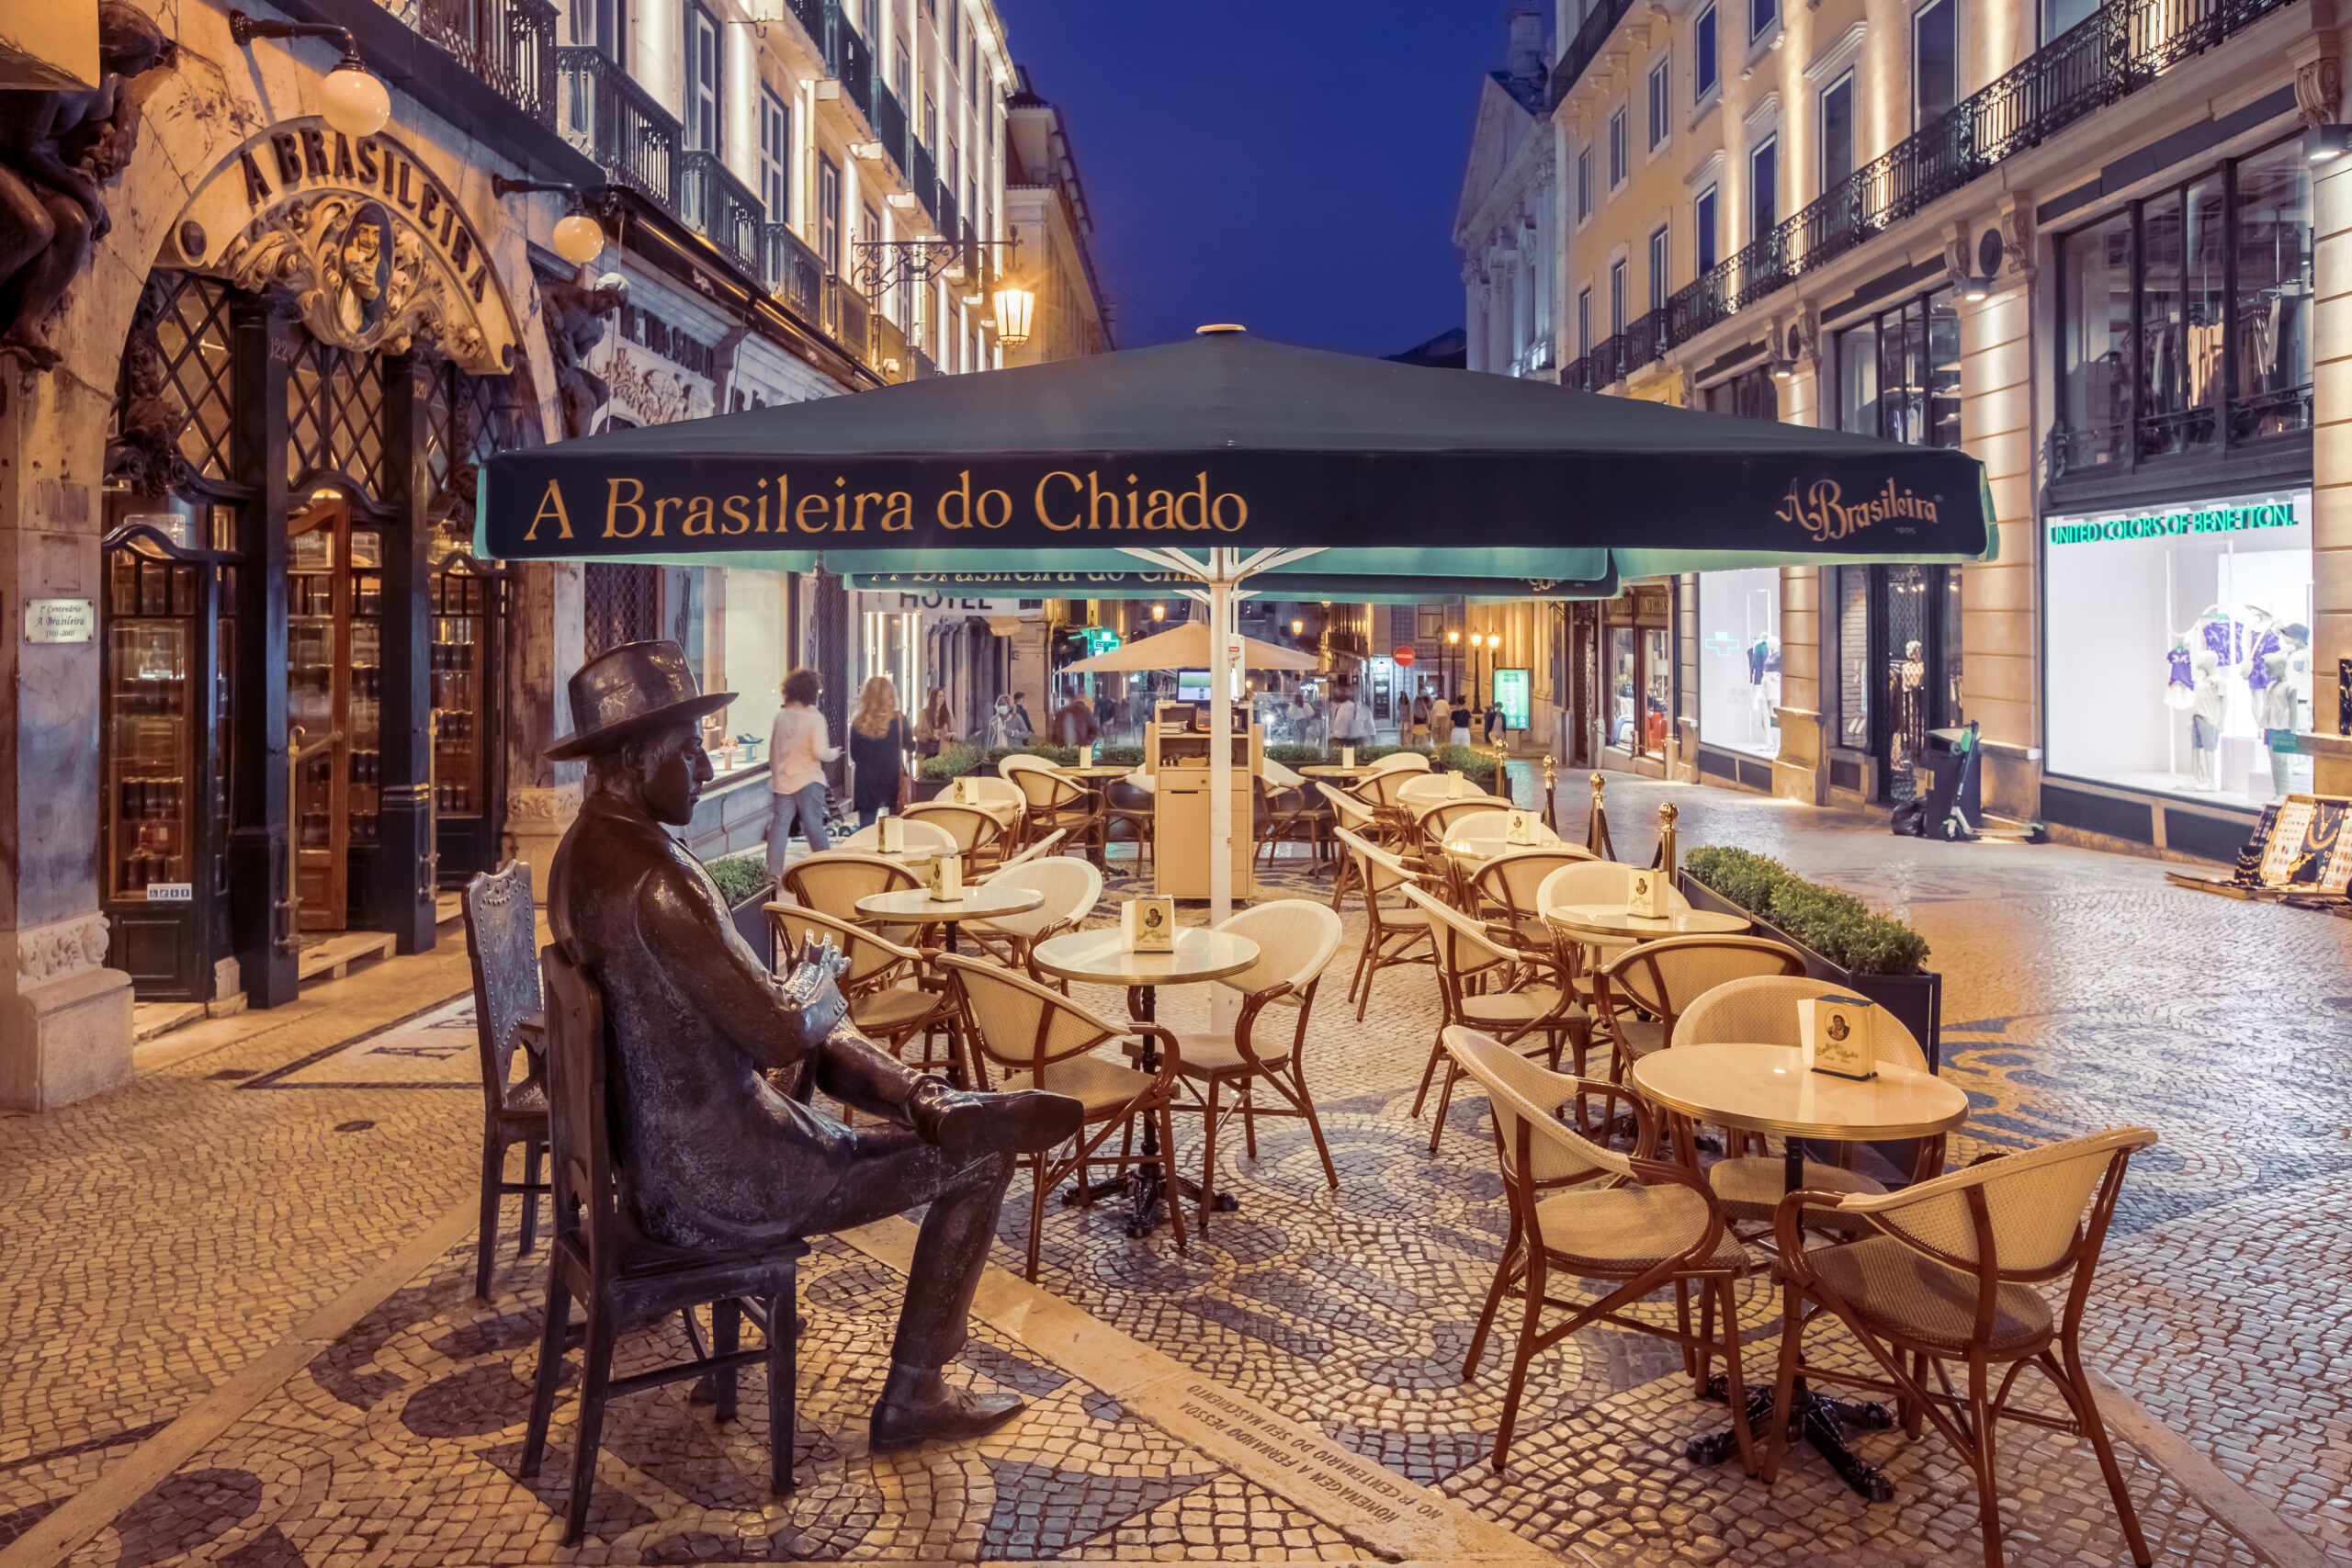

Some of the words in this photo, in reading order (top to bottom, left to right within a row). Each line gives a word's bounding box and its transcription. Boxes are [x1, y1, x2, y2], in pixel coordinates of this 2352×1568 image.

[240, 150, 273, 207] A
[271, 127, 488, 304] BRASILEIRA
[269, 336, 288, 363] 122
[523, 479, 575, 540] A
[601, 473, 915, 539] Brasileira
[936, 469, 1012, 530] do
[1035, 469, 1249, 532] Chiado
[1807, 477, 1939, 542] Brasileira
[2050, 522, 2101, 545] UNITED
[2100, 516, 2165, 541] COLORS
[2165, 512, 2193, 536] OF
[45, 615, 85, 626] Brasileira
[1177, 1402, 1231, 1431] PESSOA
[1186, 1384, 1266, 1427] NASCIMENTO
[1226, 1427, 1300, 1468] FERNANDO
[1260, 1424, 1294, 1441] SEU
[1290, 1438, 1317, 1453] DO
[1296, 1464, 1314, 1474] A
[1308, 1472, 1401, 1523] HOMENAGEM
[1416, 1504, 1444, 1520] NO
